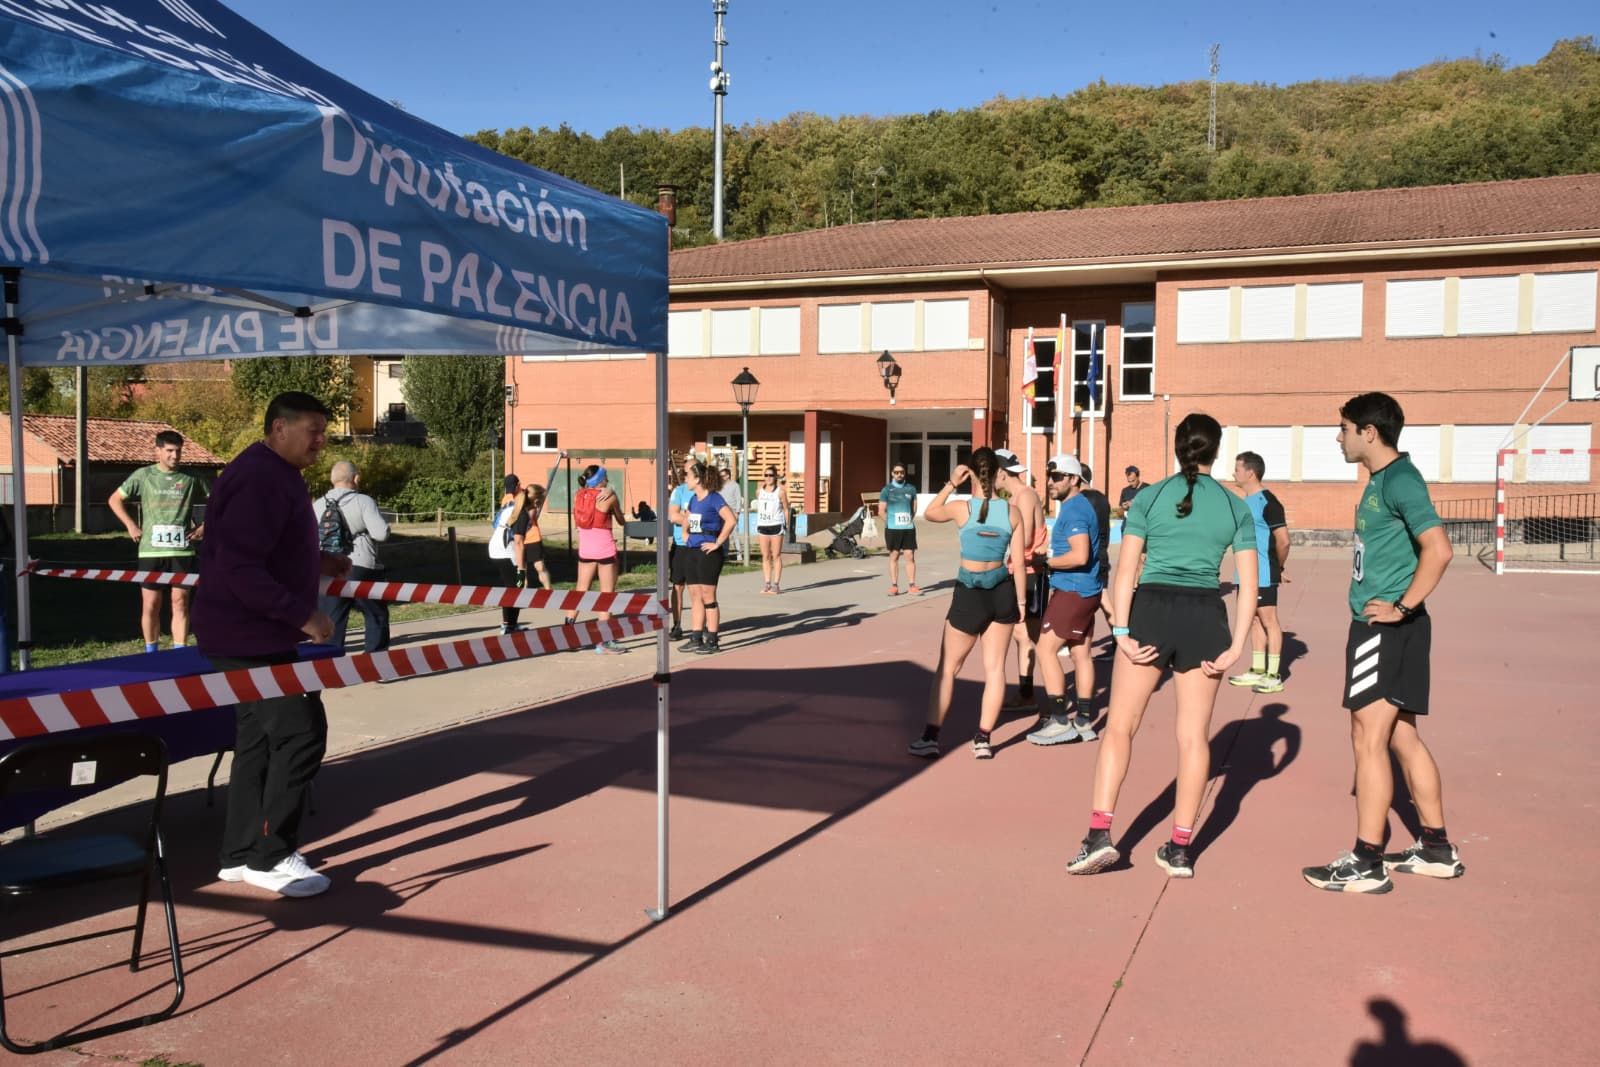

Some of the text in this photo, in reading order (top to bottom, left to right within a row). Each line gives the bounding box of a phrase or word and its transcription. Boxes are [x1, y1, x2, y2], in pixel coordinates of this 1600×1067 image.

[321, 106, 588, 250] Diputación
[322, 218, 637, 342] DE PALENCIA
[157, 532, 182, 543] 114
